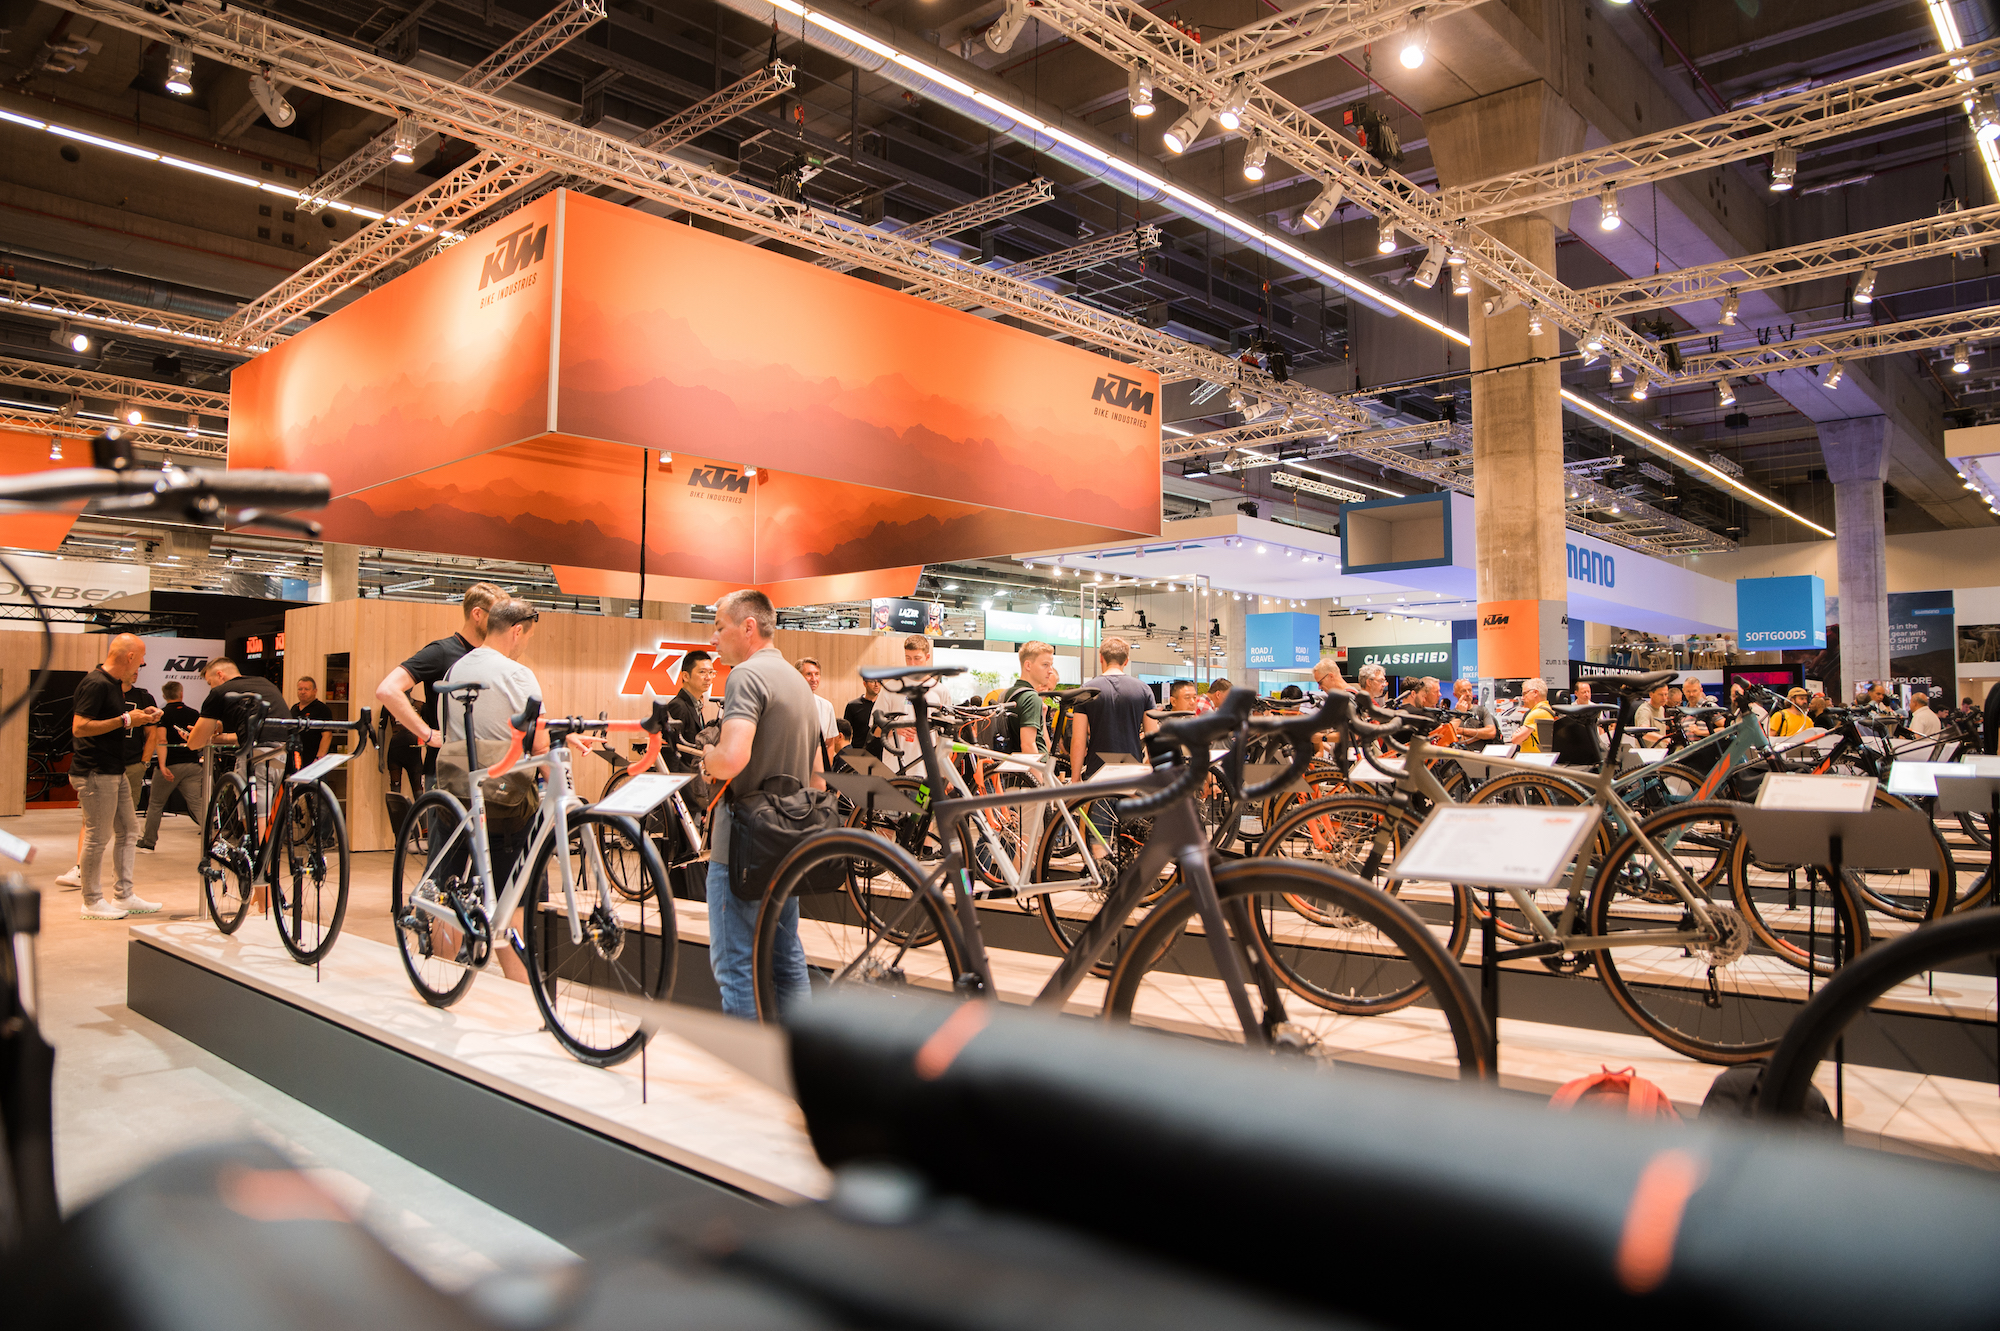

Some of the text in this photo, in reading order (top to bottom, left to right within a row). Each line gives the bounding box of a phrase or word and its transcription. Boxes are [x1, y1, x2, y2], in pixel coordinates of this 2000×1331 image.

[478, 222, 548, 291] KTM
[480, 272, 537, 309] BIKE INDUSTRIES
[1091, 372, 1154, 416] KTM
[1093, 407, 1147, 429] BIKE INDUSTRIES
[687, 464, 750, 494] KTM
[689, 490, 742, 505] BIKE INDUSTRIES
[1566, 543, 1615, 588] MANO
[1483, 613, 1510, 626] KTM
[1905, 622, 1918, 630] the
[275, 632, 285, 651] KT
[1745, 630, 1807, 642] SOFTGOODS
[1898, 636, 1920, 644] SHIFT
[246, 636, 263, 653] KTM
[1250, 647, 1268, 655] ROAD
[1295, 646, 1305, 654] ROAD
[1897, 643, 1919, 651] SHIFT
[1250, 655, 1275, 663] GRAVEL
[1295, 654, 1310, 663] GRAVEL
[1364, 651, 1449, 665] CLASSIFIED
[1891, 676, 1932, 684] XPLORE
